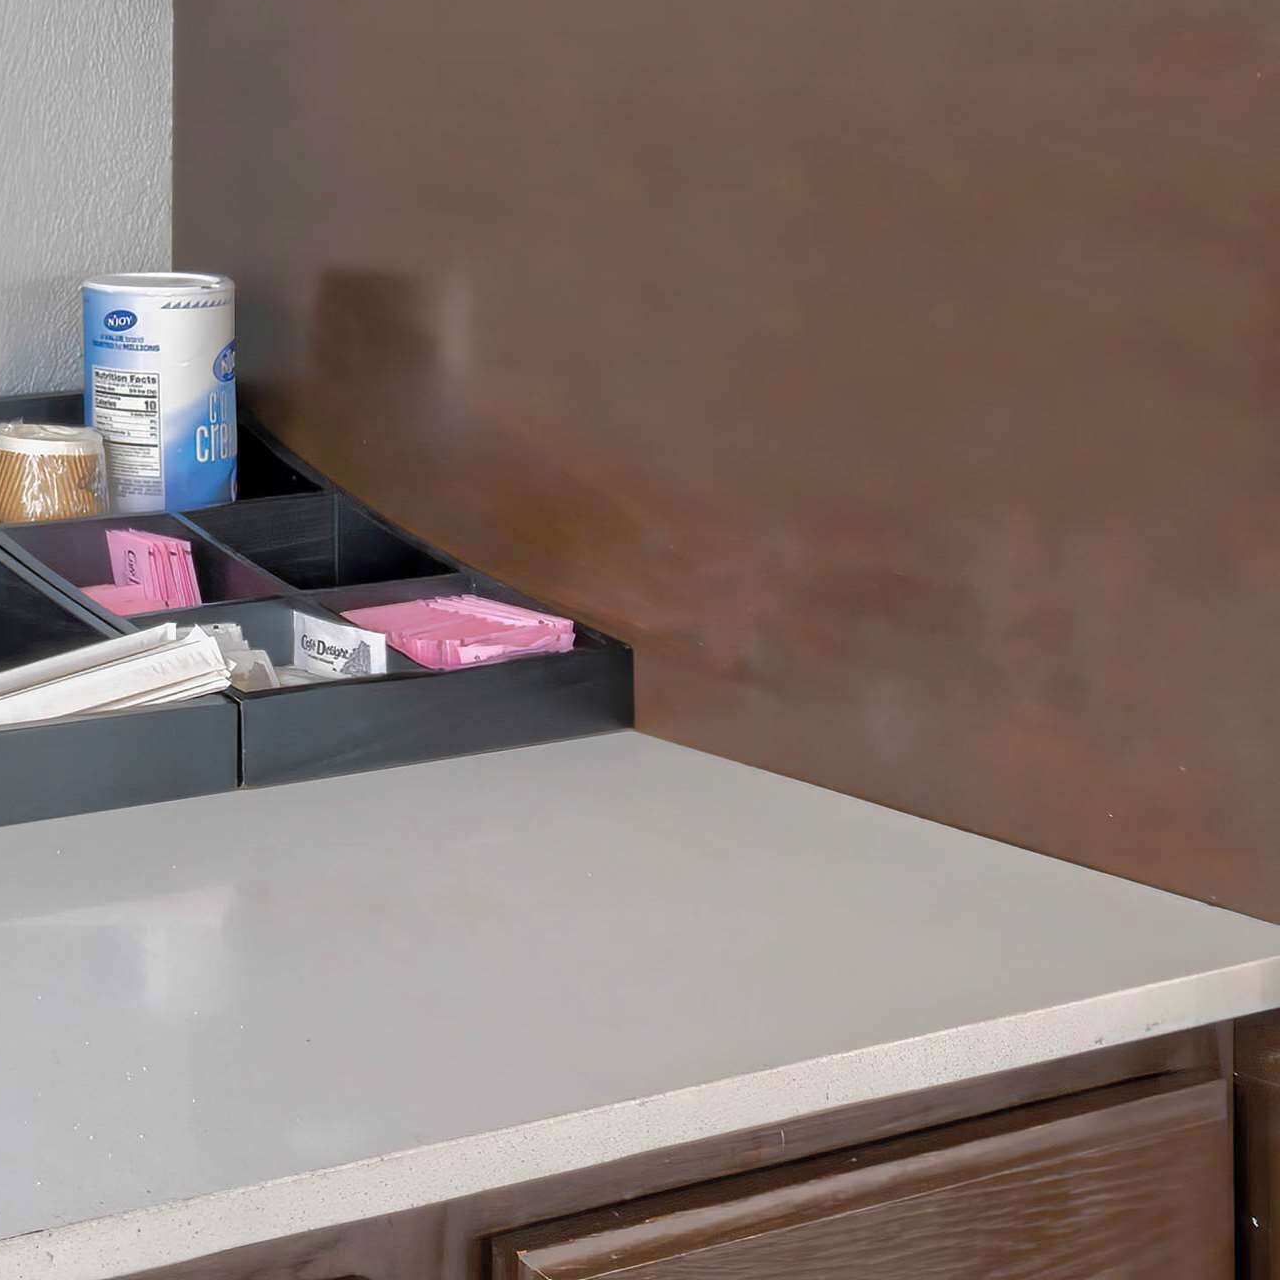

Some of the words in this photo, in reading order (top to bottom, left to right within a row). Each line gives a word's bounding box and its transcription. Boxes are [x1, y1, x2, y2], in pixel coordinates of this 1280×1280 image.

[95, 371, 126, 382] Nutrition
[130, 374, 156, 384] Facts
[144, 400, 156, 410] 10
